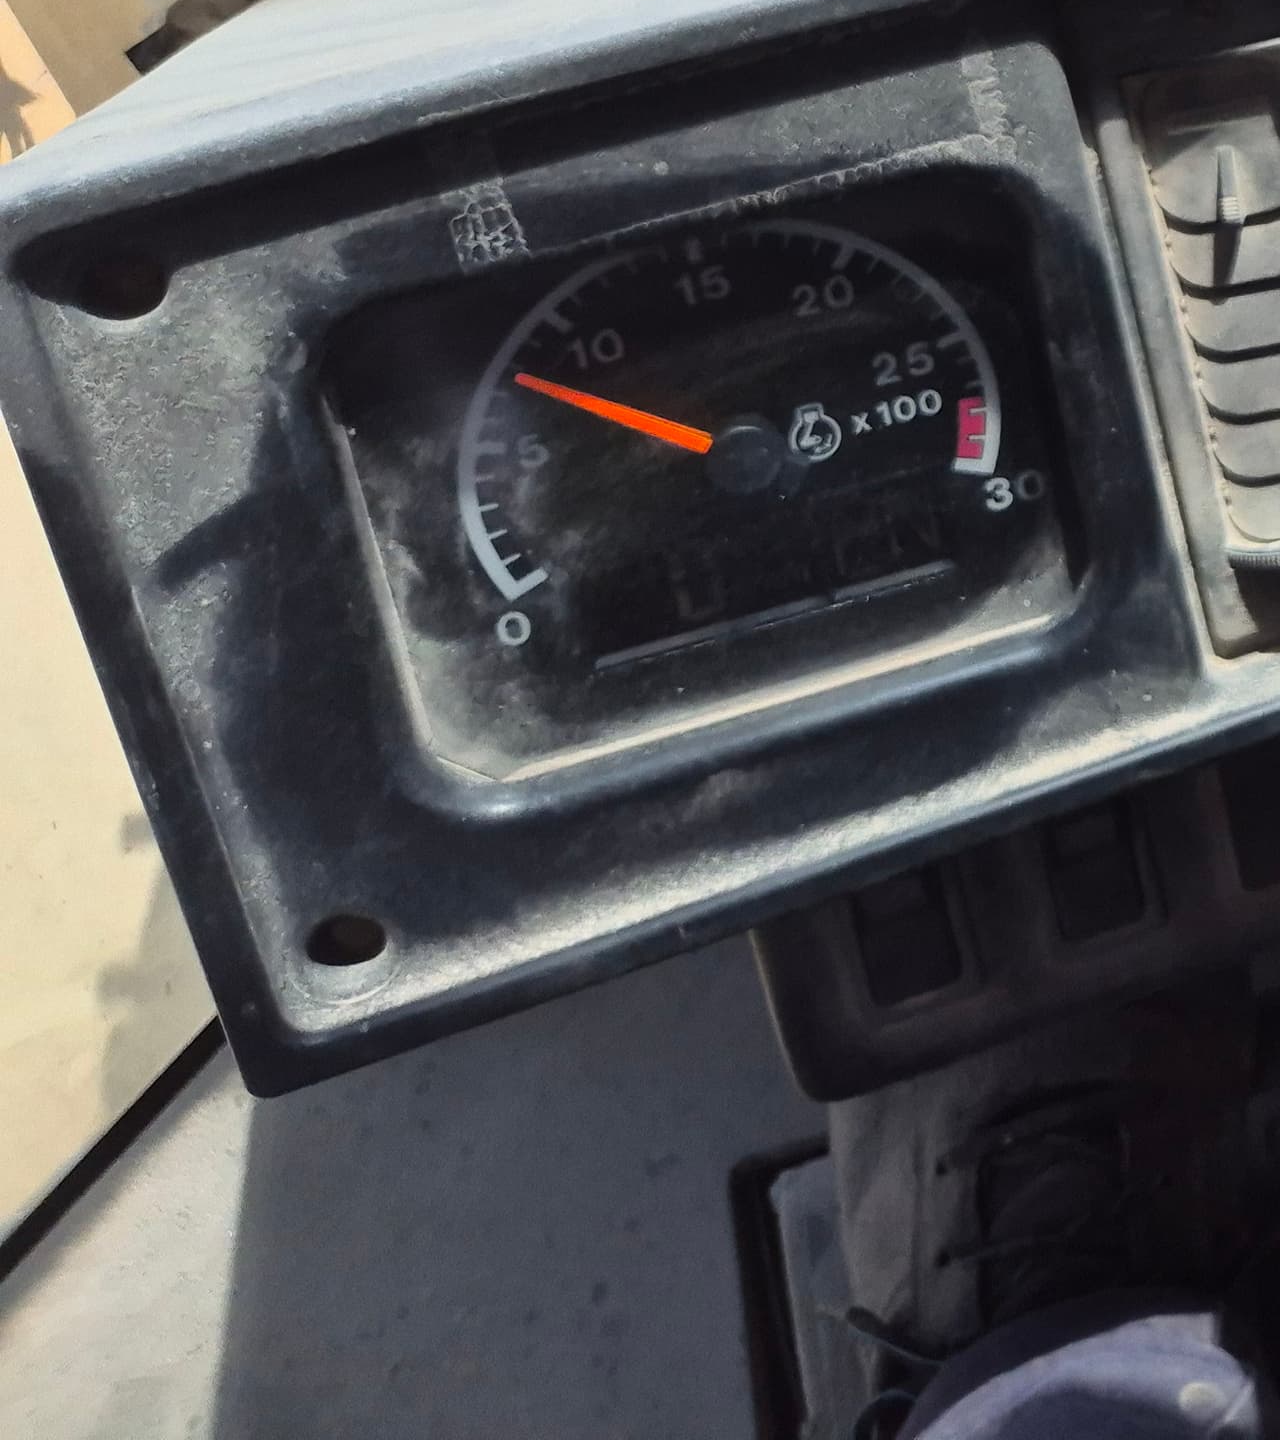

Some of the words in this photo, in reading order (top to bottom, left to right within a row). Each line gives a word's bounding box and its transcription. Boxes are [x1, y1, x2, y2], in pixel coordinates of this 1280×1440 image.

[675, 264, 731, 305] 15
[792, 274, 854, 317] 20
[566, 328, 625, 369] 10
[872, 341, 936, 386] 25
[517, 433, 550, 469] 5
[984, 470, 1045, 511] 30
[496, 610, 532, 647] 0
